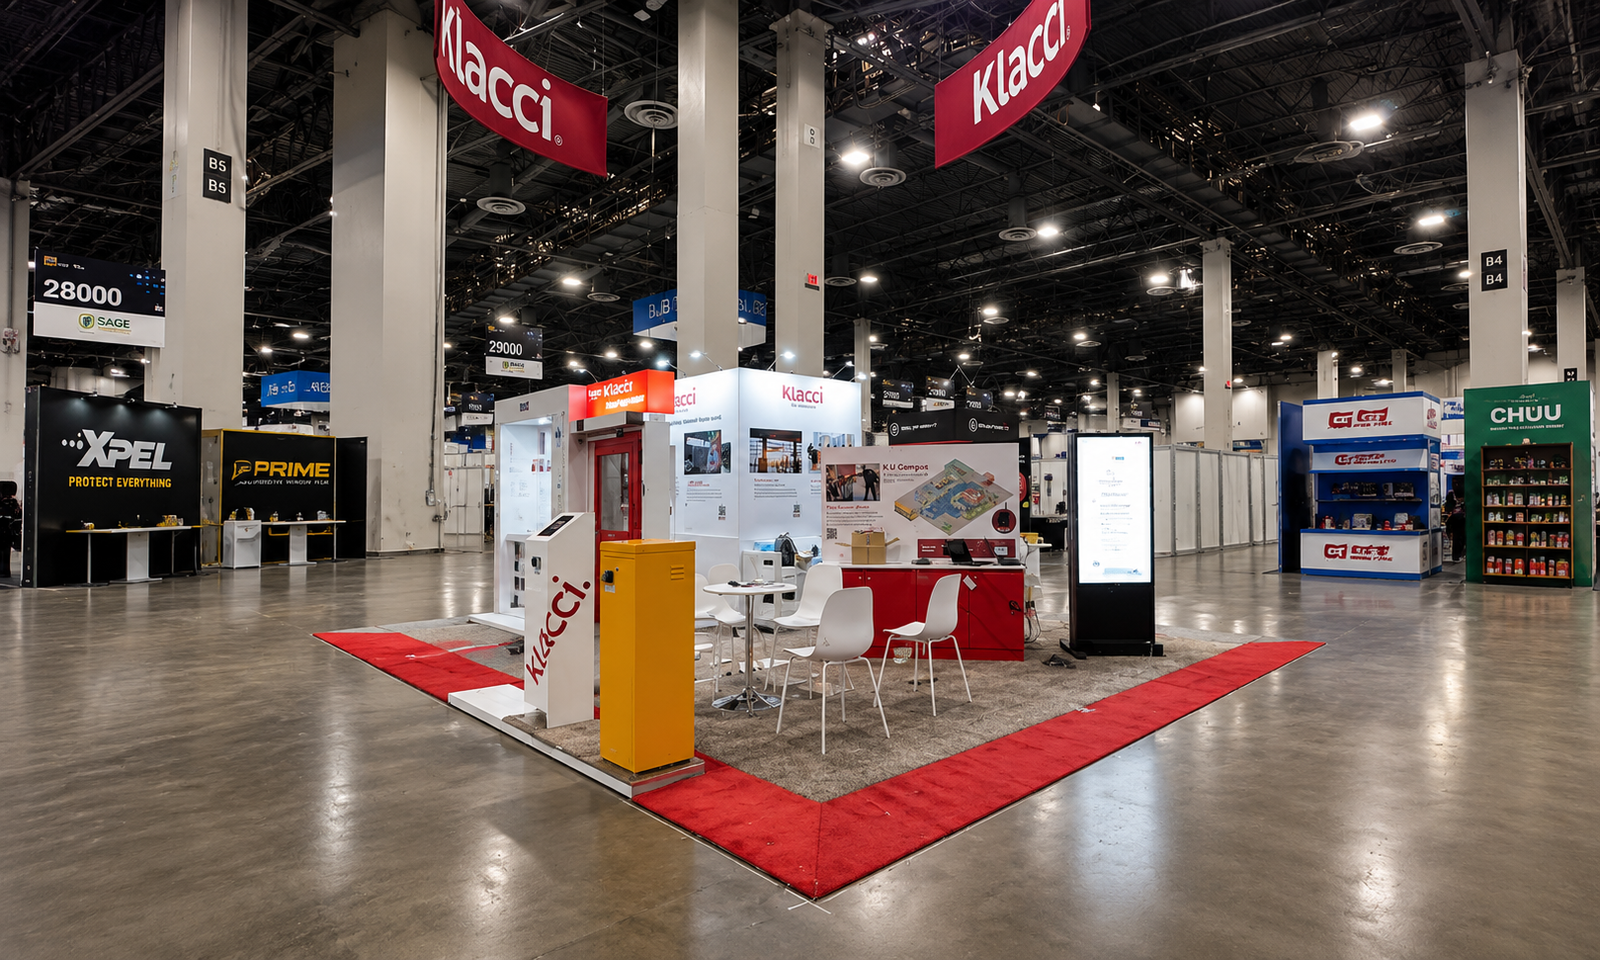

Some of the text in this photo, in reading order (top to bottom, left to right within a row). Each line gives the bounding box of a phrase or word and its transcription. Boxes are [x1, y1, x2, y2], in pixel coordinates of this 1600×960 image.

[441, 0, 551, 141] Klacci
[973, 0, 1067, 125] Klacci
[1486, 254, 1503, 267] B4
[1486, 273, 1504, 285] B4
[43, 279, 122, 307] 28000
[98, 316, 131, 329] SAGE
[489, 340, 523, 356] 29000
[674, 386, 696, 408] acci
[782, 384, 824, 404] Klacci
[1490, 404, 1562, 424] CHUU
[76, 429, 172, 470] XPEL
[253, 460, 331, 478] PRIME
[68, 476, 172, 488] PROTECT EVERYTHING
